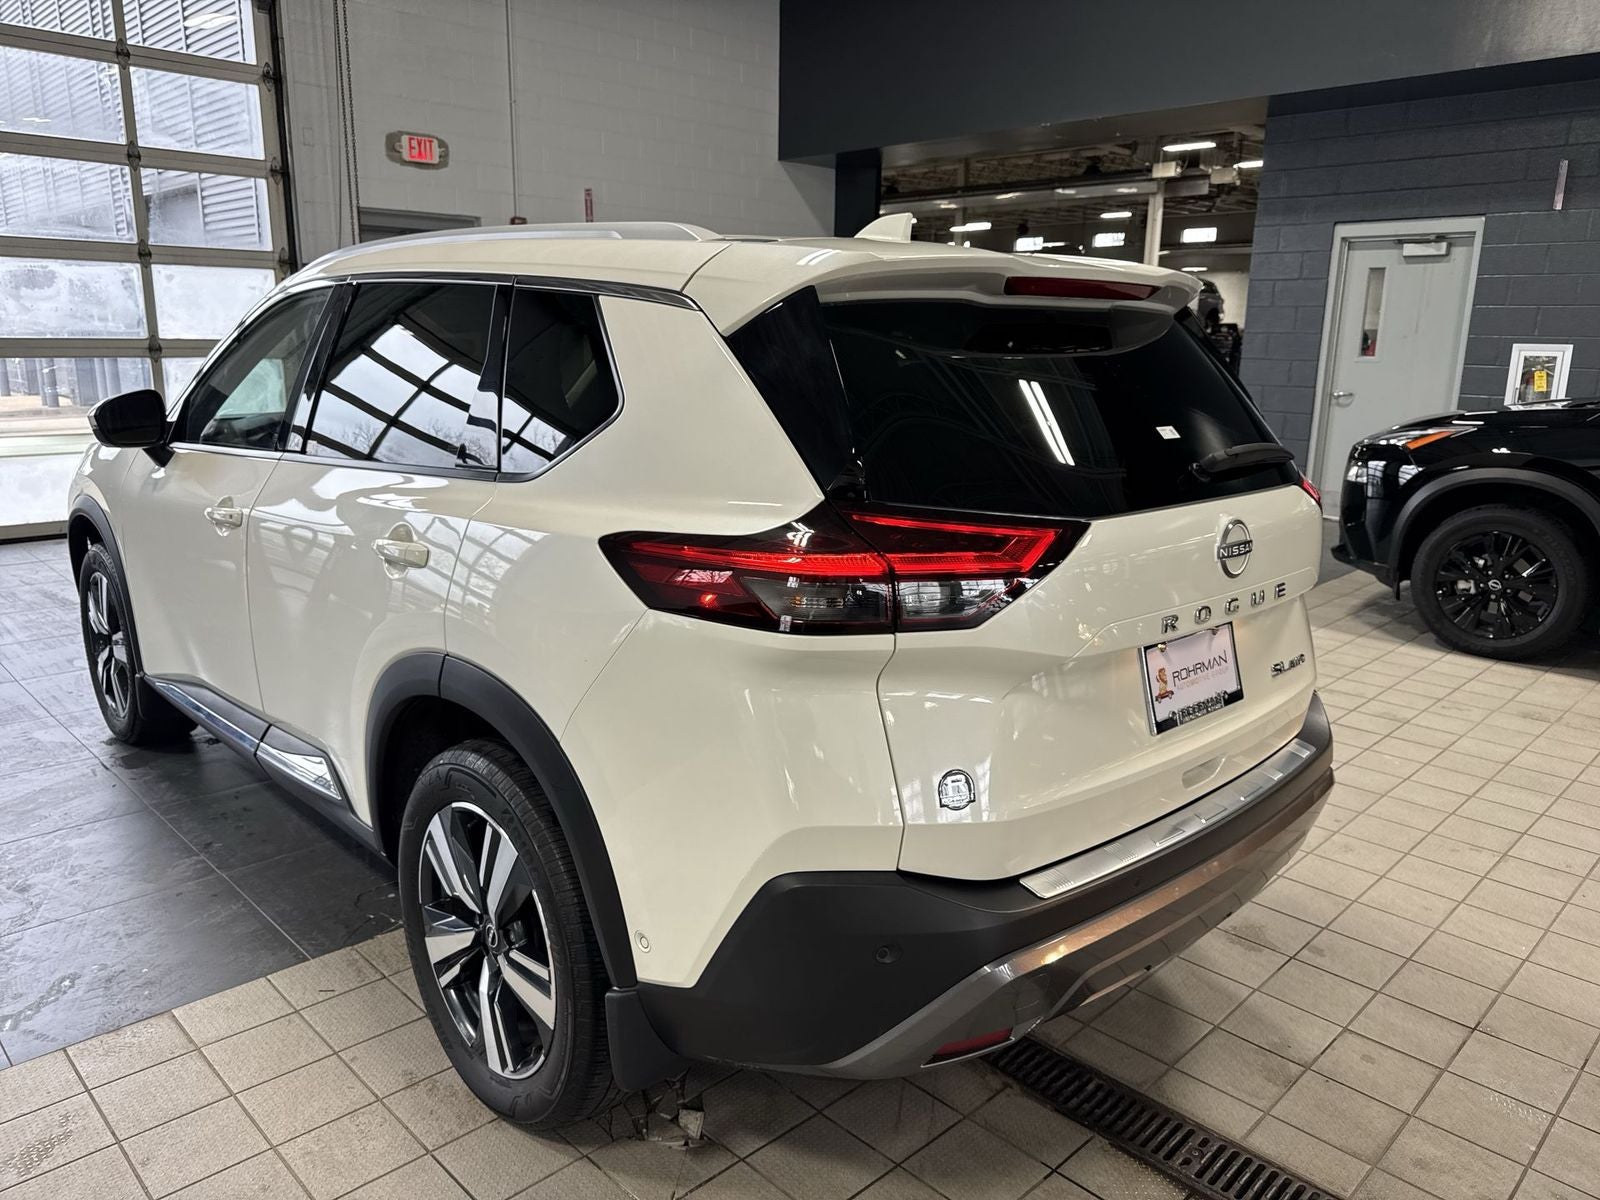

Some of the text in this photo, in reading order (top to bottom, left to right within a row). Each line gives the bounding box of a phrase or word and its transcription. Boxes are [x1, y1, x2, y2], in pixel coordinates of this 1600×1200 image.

[408, 136, 434, 160] EXIT
[1161, 582, 1286, 635] ROGUE
[1172, 649, 1228, 687] ROHRMAN
